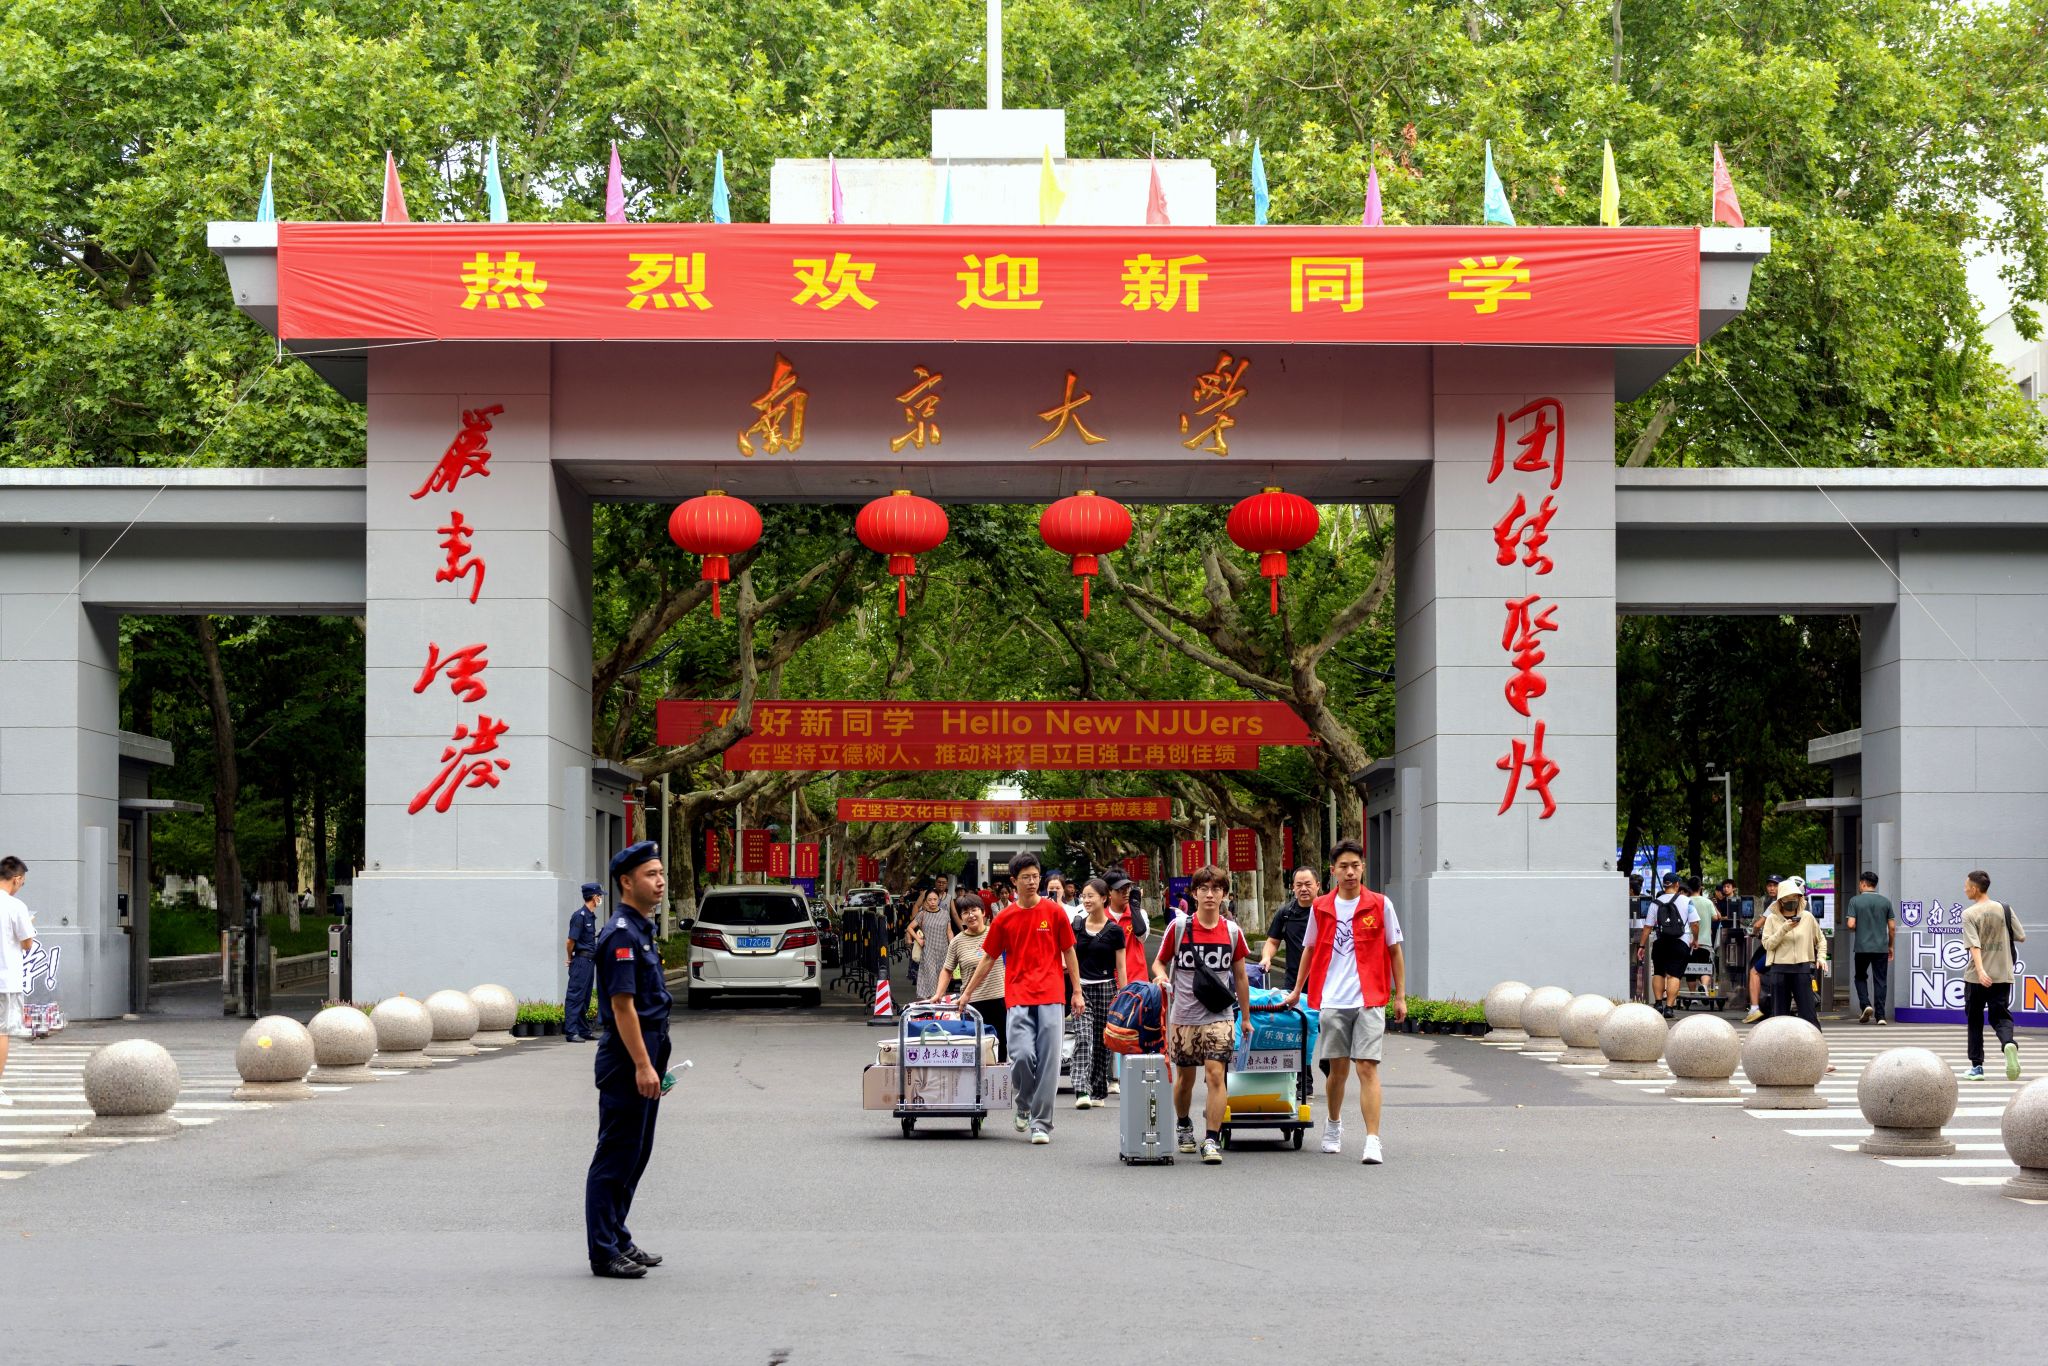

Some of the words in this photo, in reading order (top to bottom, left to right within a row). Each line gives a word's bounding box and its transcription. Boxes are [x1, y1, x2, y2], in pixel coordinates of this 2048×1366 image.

[459, 250, 1532, 315] 热烈欢迎新同学
[941, 708, 1033, 736] Hello
[1045, 708, 1123, 736] New
[1135, 708, 1264, 737] NJUers
[1927, 926, 1960, 935] NANJING
